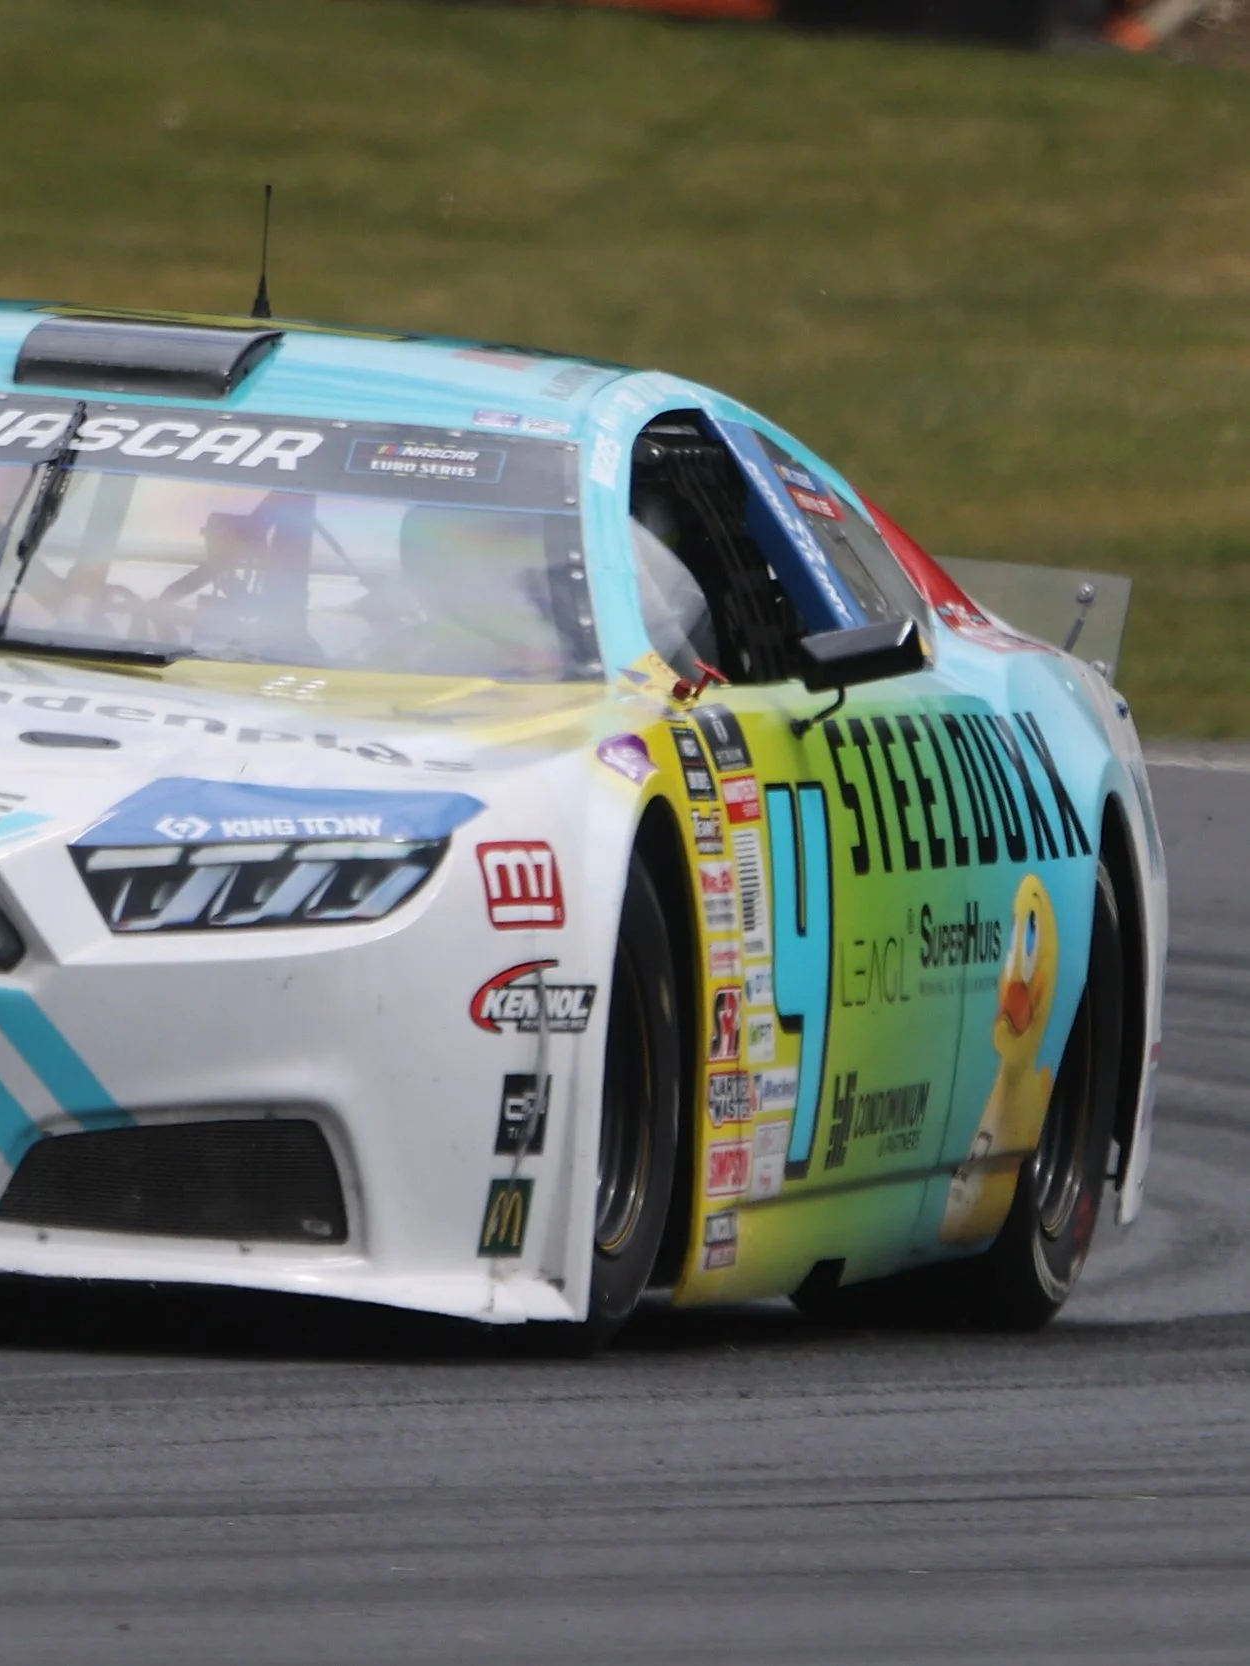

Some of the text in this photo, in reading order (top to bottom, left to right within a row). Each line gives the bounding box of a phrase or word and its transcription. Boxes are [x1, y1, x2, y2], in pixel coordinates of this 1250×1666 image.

[401, 446, 480, 461] NASCAR
[370, 460, 477, 478] EURO SERIES
[220, 816, 384, 838] KING TONY
